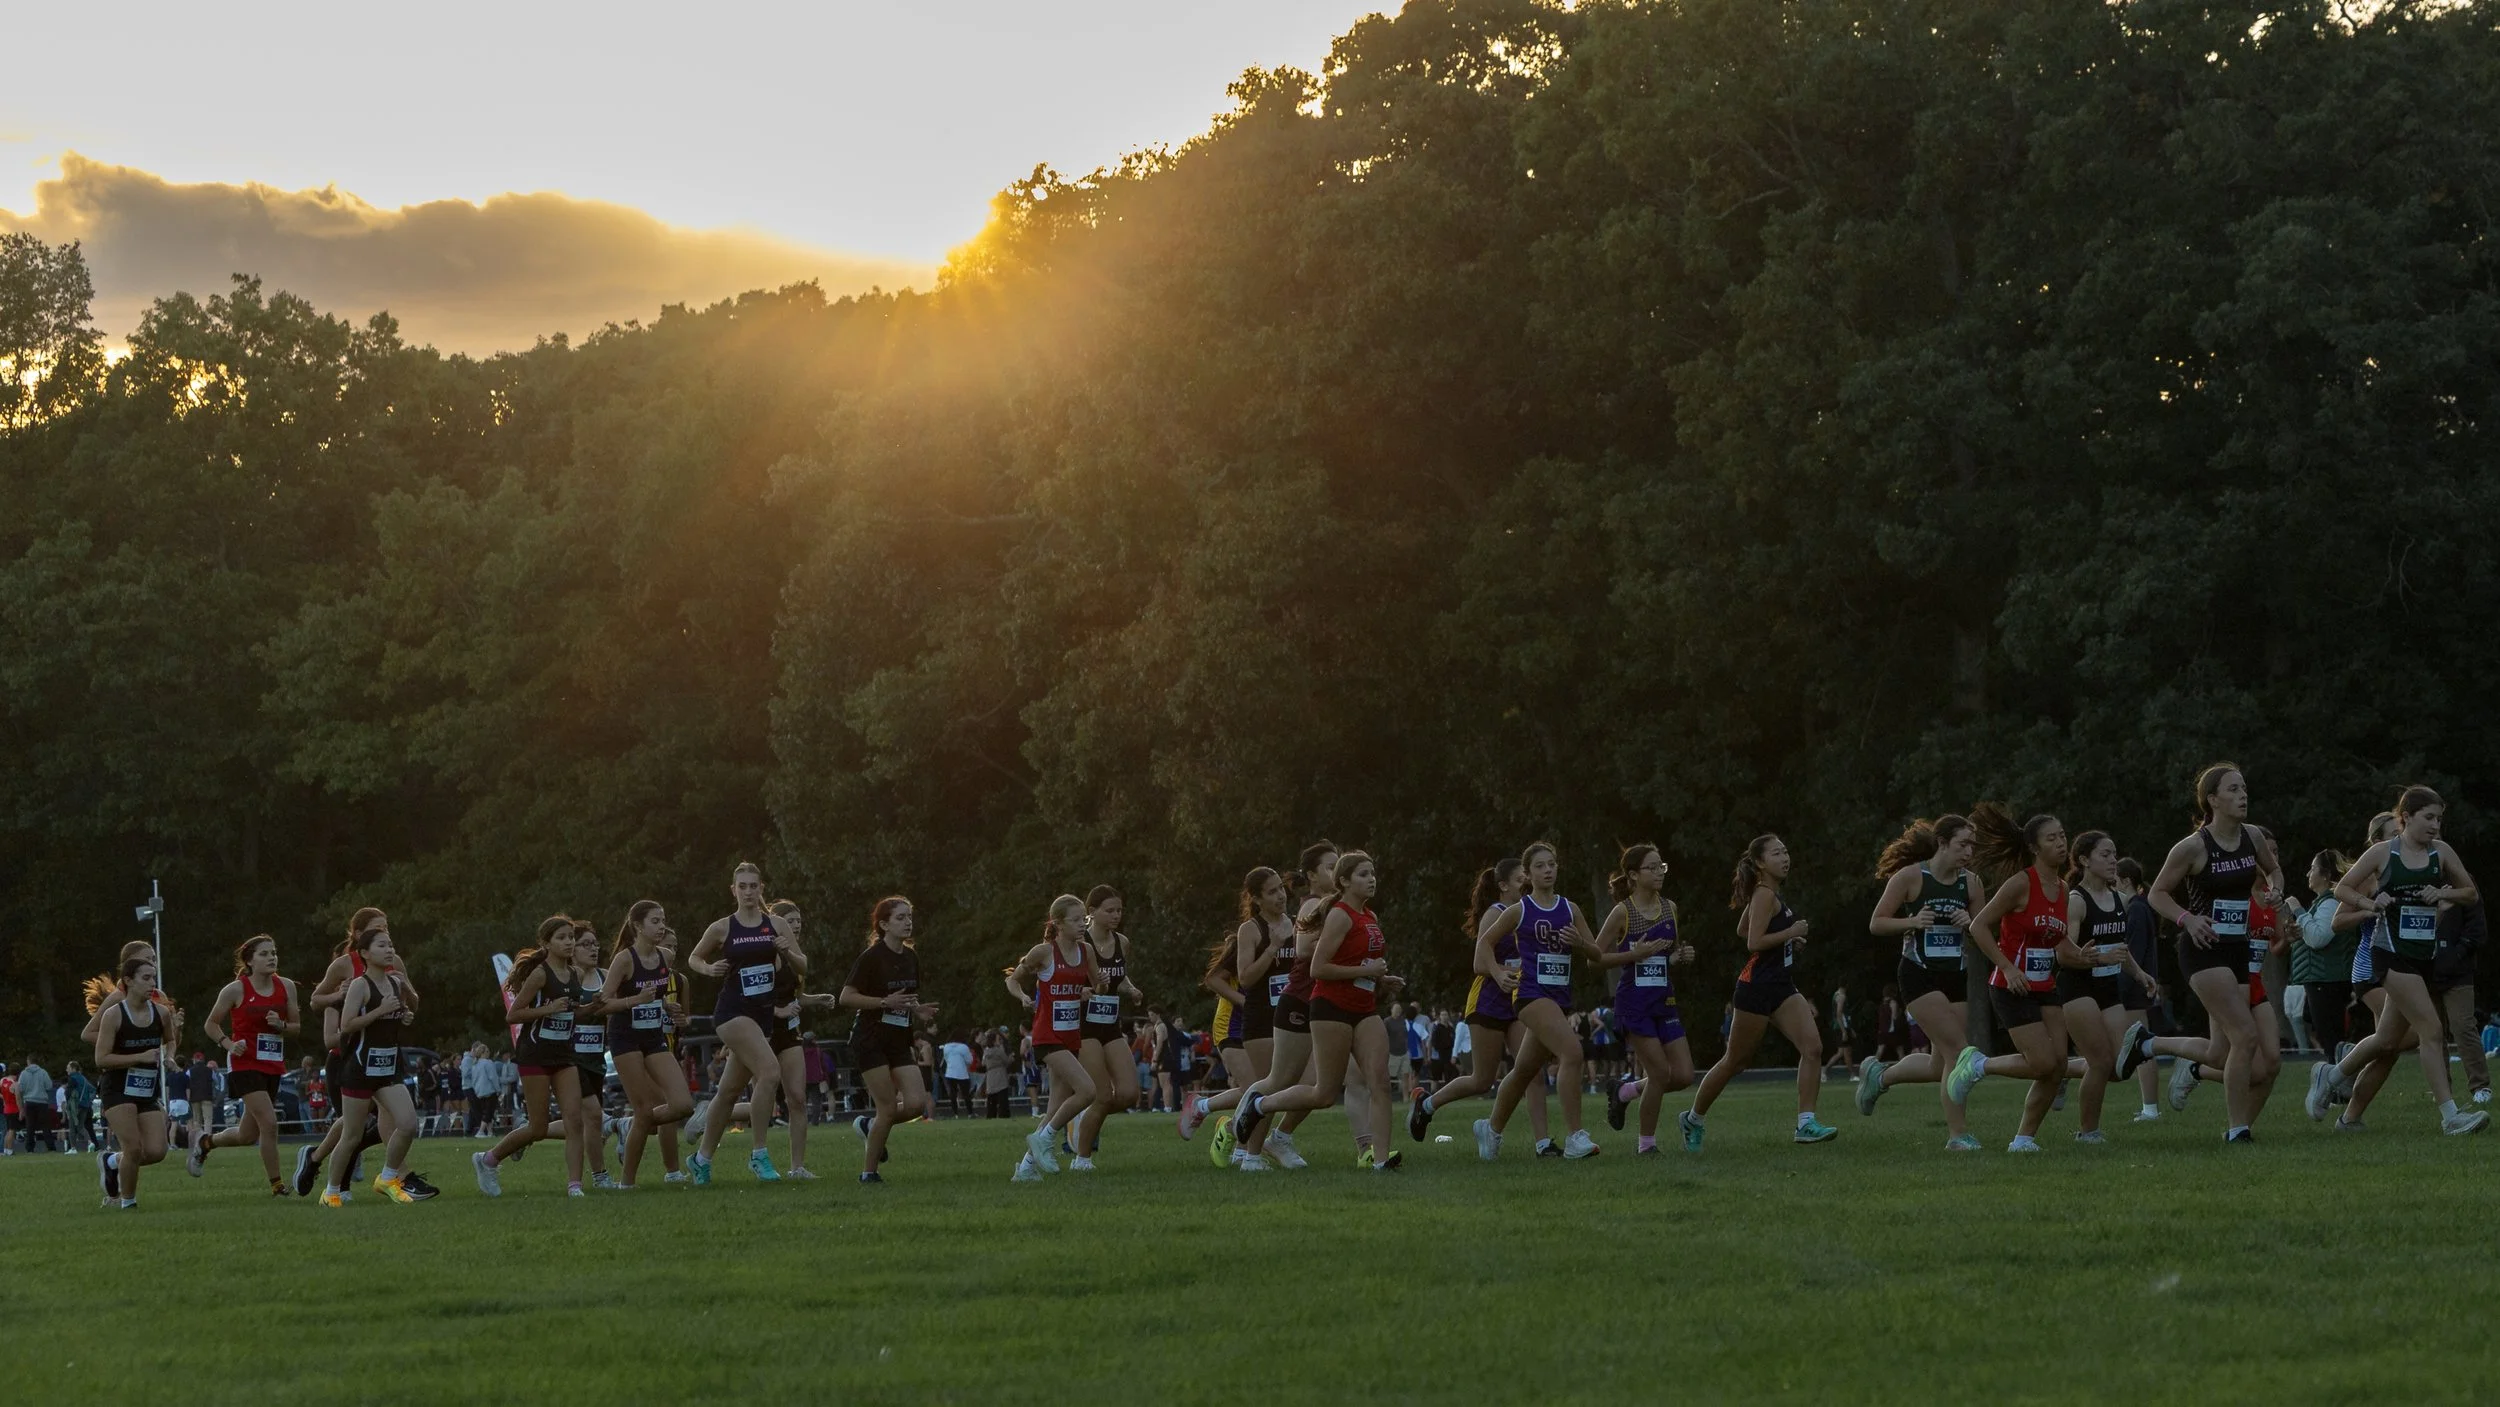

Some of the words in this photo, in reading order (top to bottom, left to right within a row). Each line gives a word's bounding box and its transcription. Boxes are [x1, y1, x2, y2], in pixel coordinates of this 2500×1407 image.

[2211, 859, 2240, 873] FLORAL
[2034, 915, 2047, 926] V.S.
[2221, 911, 2243, 922] 3104
[2410, 918, 2429, 927] 3377
[2092, 921, 2126, 936] MINEOLA
[1933, 935, 1954, 945] 3378
[1643, 966, 1663, 976] 3664
[749, 974, 769, 985] 3425
[1050, 984, 1073, 995] GLEN
[639, 1009, 658, 1019] 3435
[1096, 1005, 1112, 1013] 3471
[579, 1034, 600, 1043] 4990
